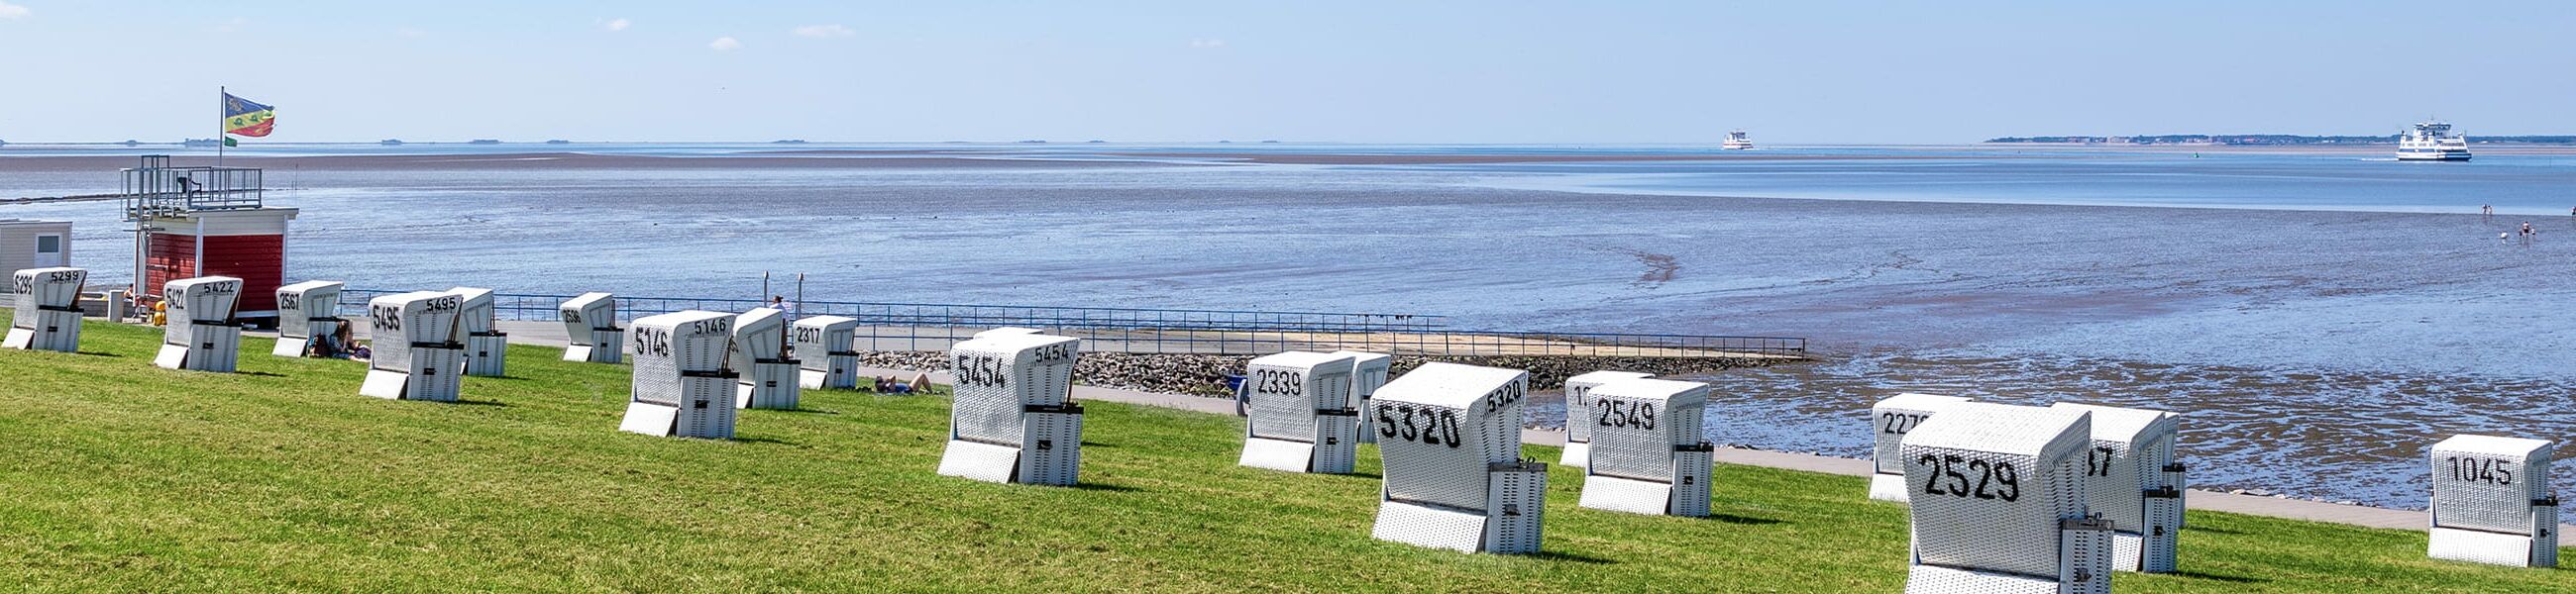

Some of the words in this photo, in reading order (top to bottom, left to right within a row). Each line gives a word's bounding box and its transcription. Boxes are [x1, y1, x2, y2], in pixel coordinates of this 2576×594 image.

[15, 274, 33, 295] 5299
[52, 270, 79, 282] 5299
[204, 281, 234, 294] 5422
[166, 288, 184, 310] 5422
[279, 292, 300, 311] 2567
[427, 297, 457, 312] 5495
[373, 305, 400, 332] 5495
[695, 318, 727, 335] 5146
[635, 326, 669, 356] 5146
[797, 327, 820, 344] 2317
[1034, 344, 1069, 363] 5454
[958, 354, 1006, 388] 5454
[1257, 369, 1301, 396] 2339
[1486, 379, 1522, 413] 5320
[1378, 404, 1460, 448] 5320
[1598, 397, 1655, 431] 2549
[1918, 453, 2019, 503] 2529
[2447, 456, 2512, 485] 1045
